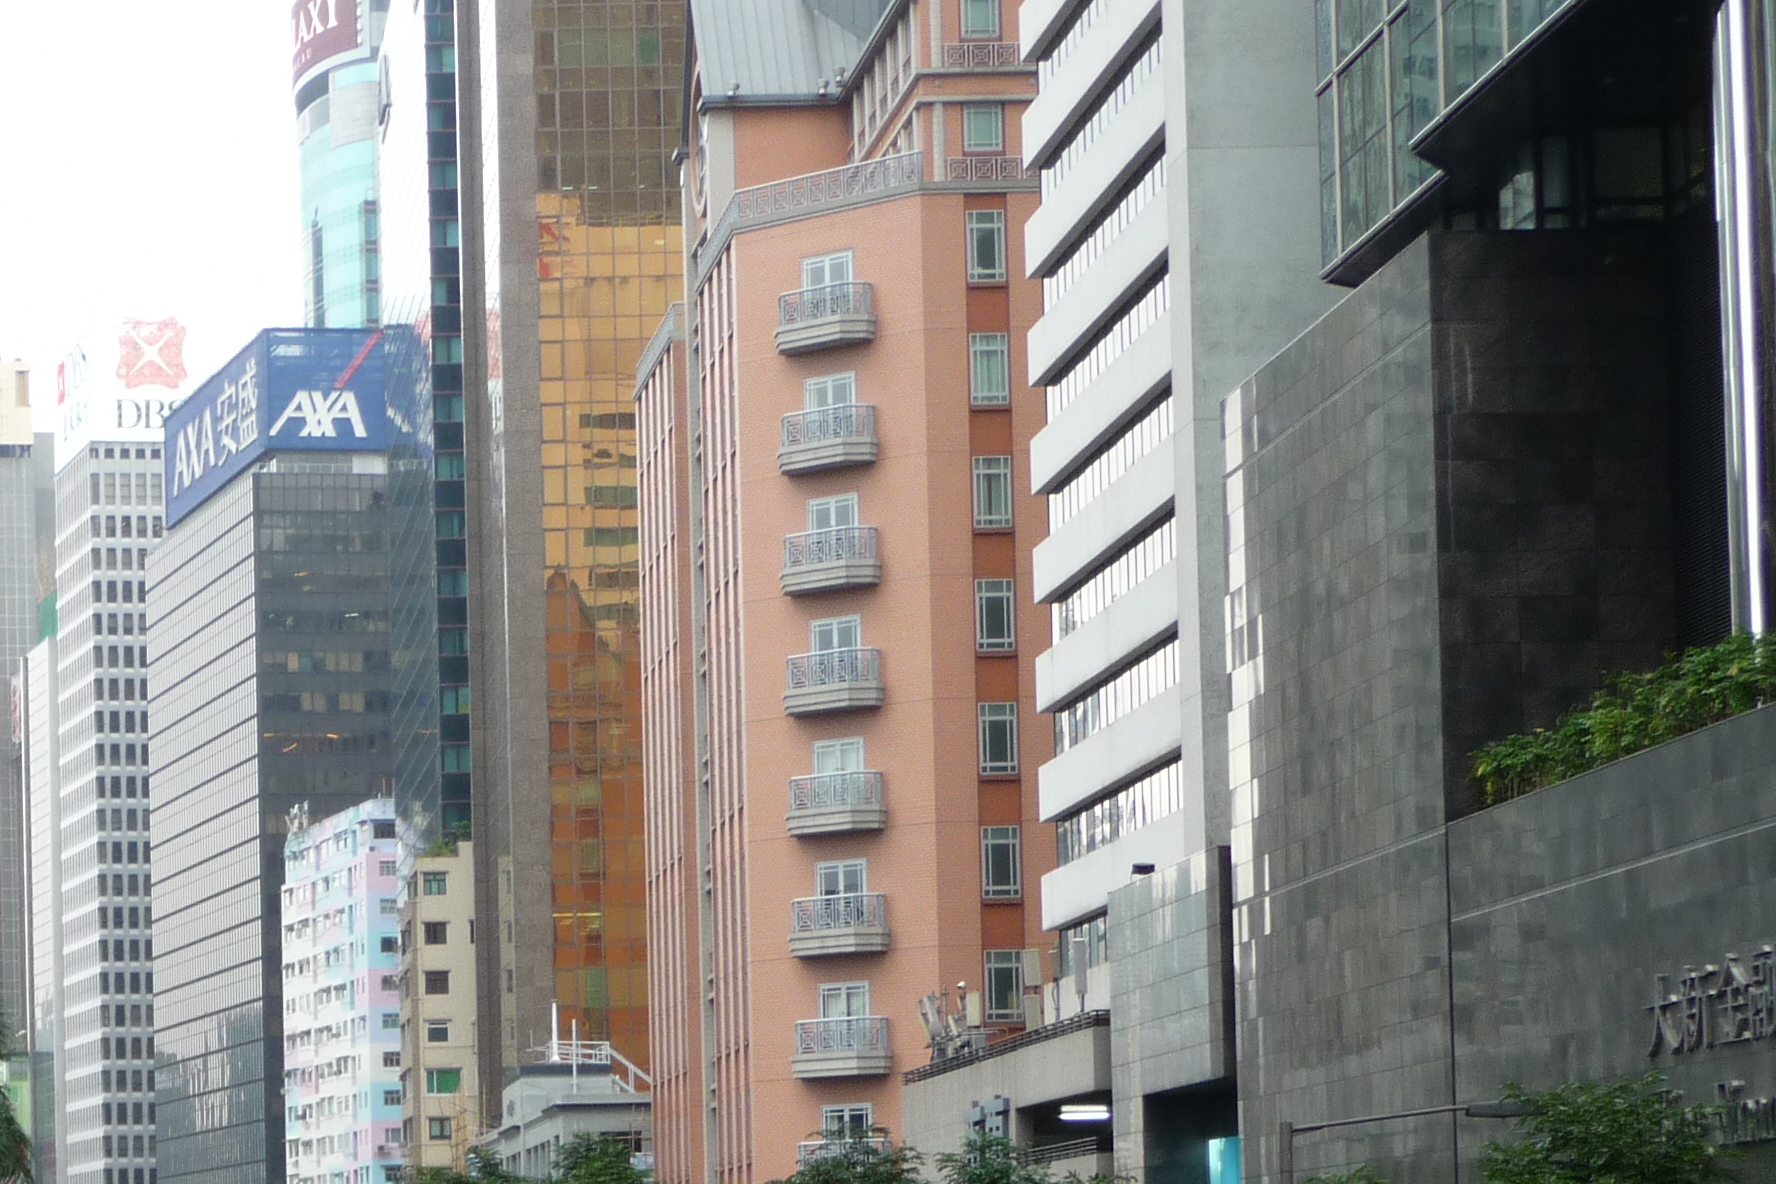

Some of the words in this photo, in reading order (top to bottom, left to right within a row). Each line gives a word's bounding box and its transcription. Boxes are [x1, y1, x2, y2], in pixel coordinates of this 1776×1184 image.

[173, 406, 216, 498] AXA
[217, 357, 260, 467] 安盛
[268, 390, 368, 438] AXA
